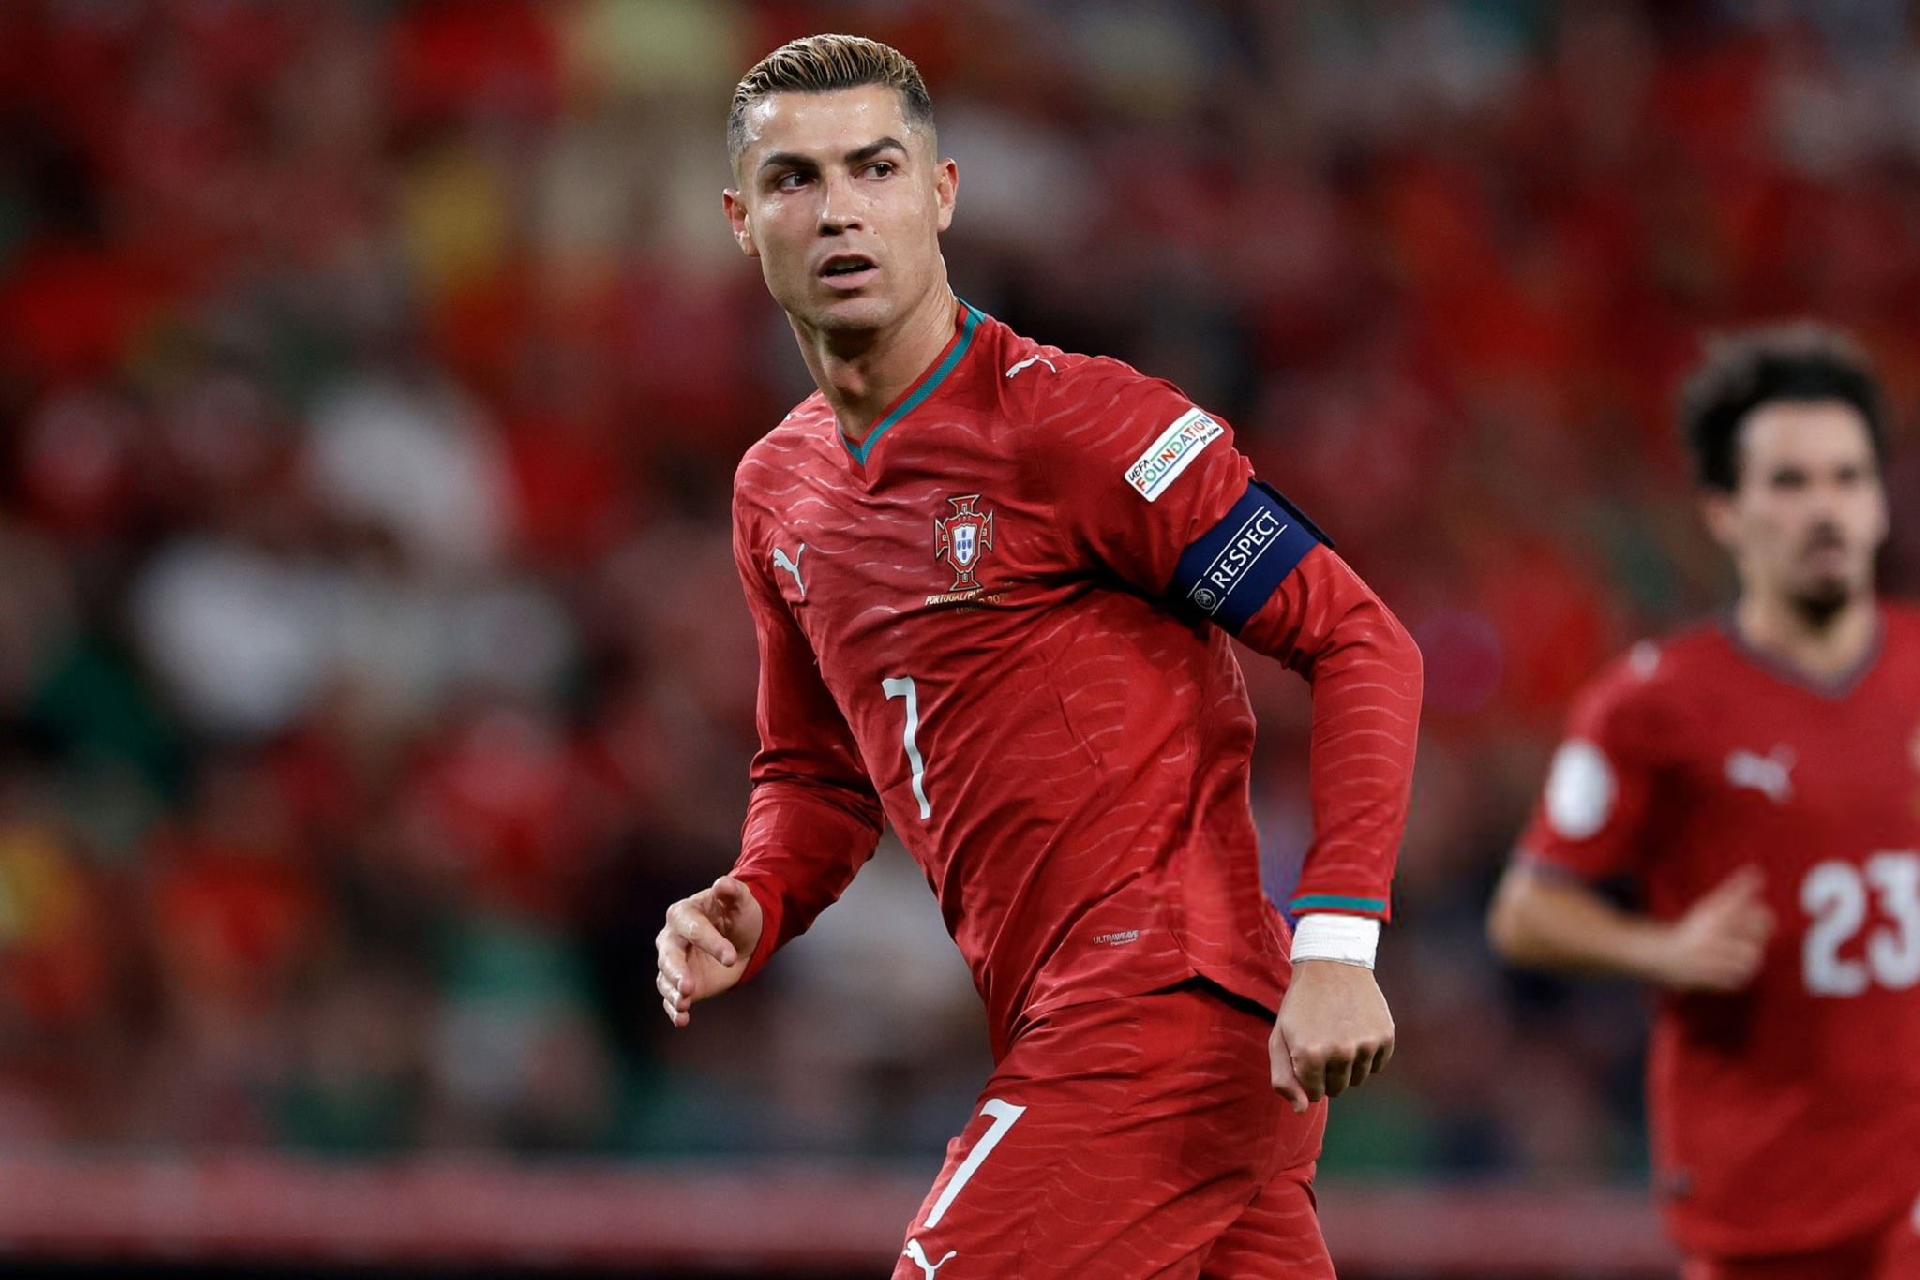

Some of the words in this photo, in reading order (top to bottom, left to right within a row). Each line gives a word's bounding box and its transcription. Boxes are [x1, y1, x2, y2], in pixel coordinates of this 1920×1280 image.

[1128, 459, 1149, 481] UEFA
[1135, 416, 1213, 491] FOUNDATION
[1210, 510, 1279, 589] RESPECT
[882, 677, 931, 820] 7
[1800, 853, 1920, 997] 23
[923, 1099, 1027, 1228] 7
